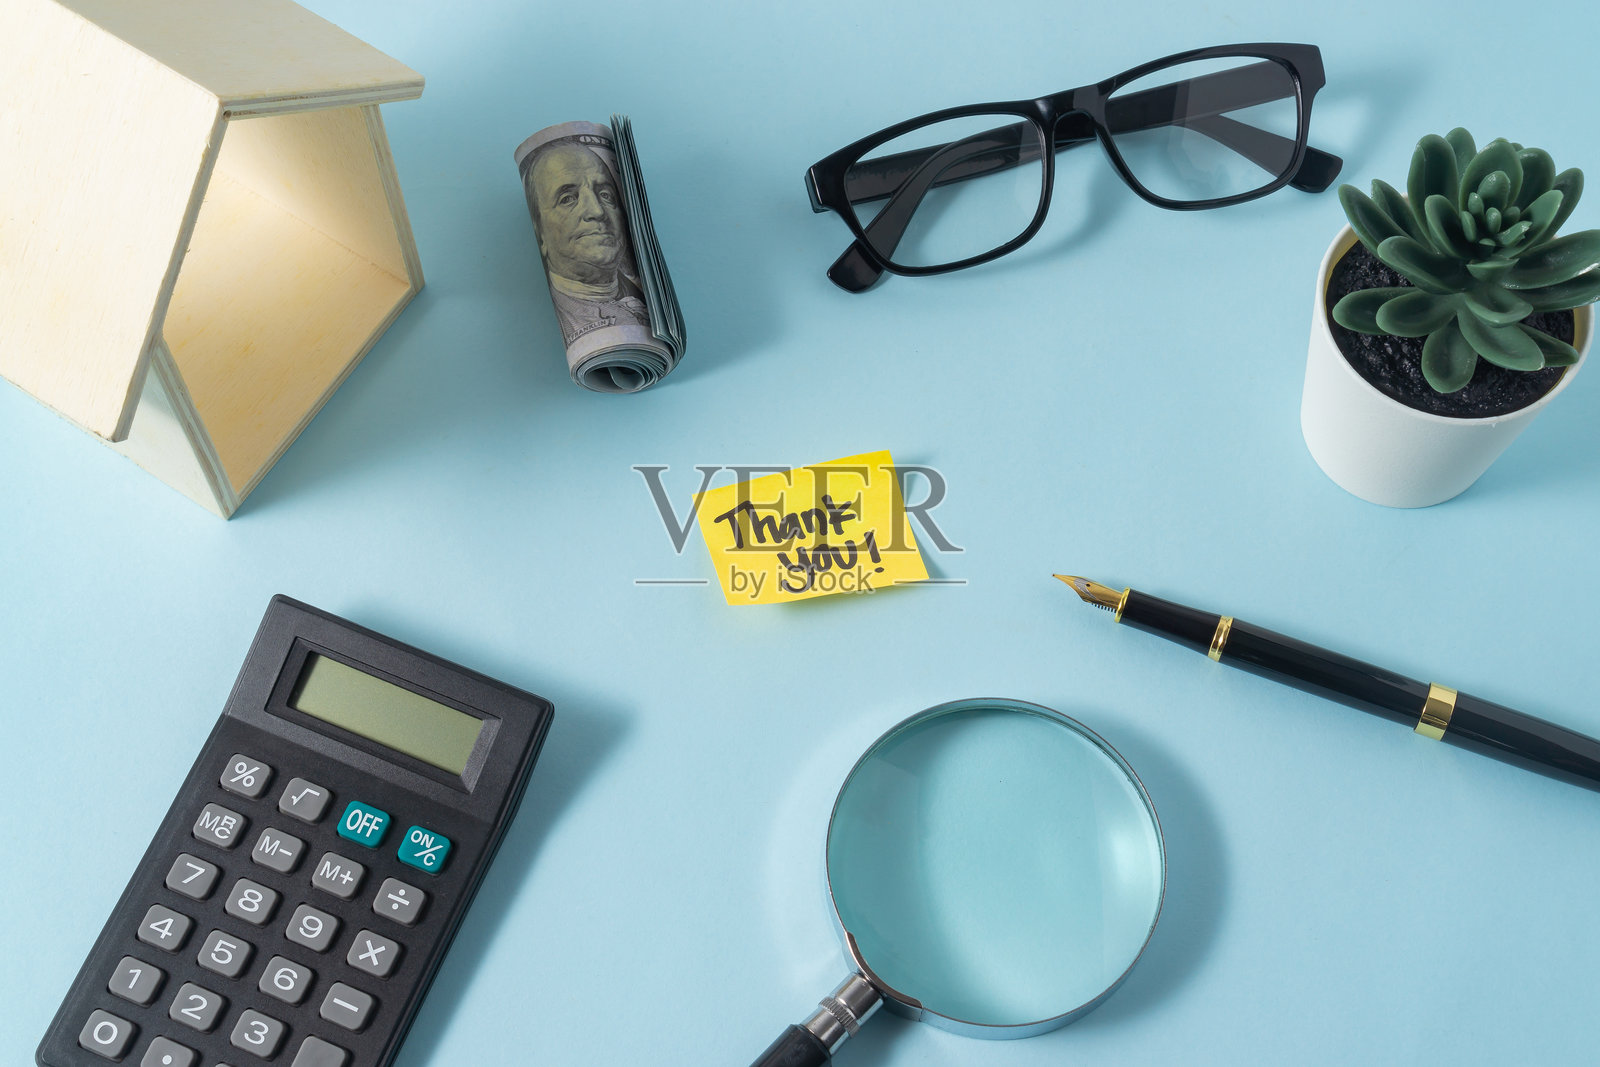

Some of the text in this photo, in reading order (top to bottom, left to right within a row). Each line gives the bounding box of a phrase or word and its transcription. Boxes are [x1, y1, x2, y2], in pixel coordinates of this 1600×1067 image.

[570, 319, 607, 340] FRANKLIN
[713, 493, 857, 549] Thank
[776, 529, 885, 593] you!
[229, 761, 261, 788] %
[346, 808, 383, 838] OFF
[182, 862, 206, 884] 7
[319, 860, 354, 885] M+
[237, 888, 263, 913] 8
[149, 917, 174, 940] 4
[298, 915, 324, 939] 9
[210, 939, 237, 965] 5
[128, 968, 142, 990] 1
[272, 967, 299, 991] 6
[180, 994, 208, 1021] 2
[92, 1021, 119, 1046] 0
[243, 1020, 270, 1046] 3
